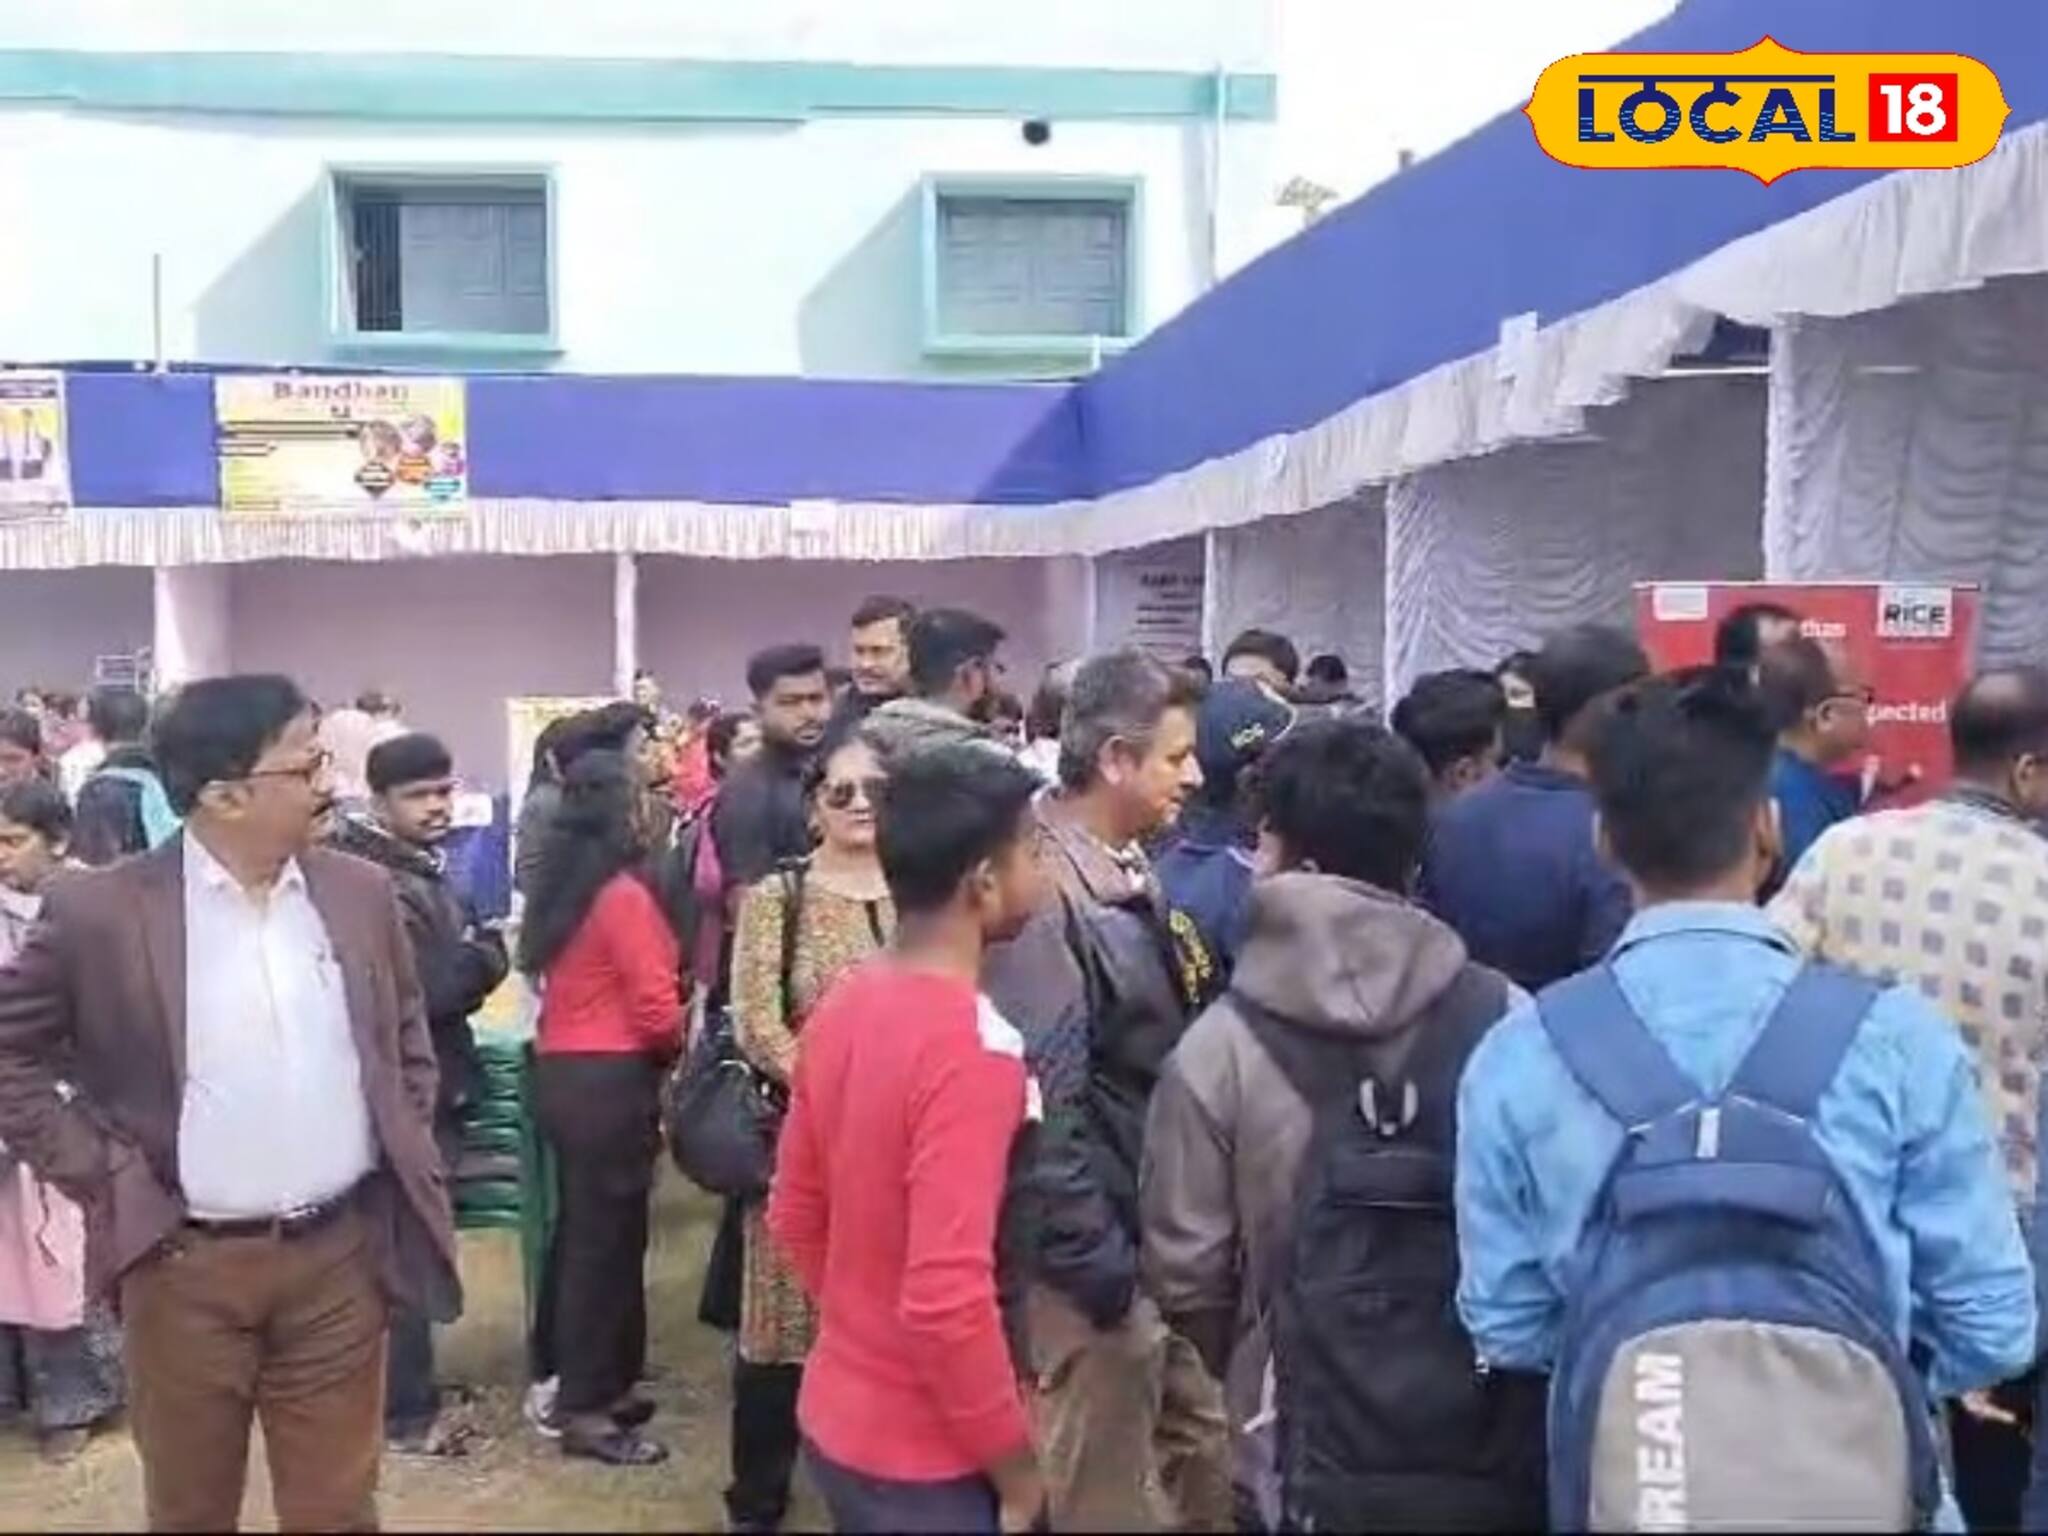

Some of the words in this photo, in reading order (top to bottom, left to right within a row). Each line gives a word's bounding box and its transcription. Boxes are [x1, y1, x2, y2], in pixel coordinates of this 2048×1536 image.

[1884, 604, 1945, 625] RICE
[1866, 700, 1946, 727] pected
[1635, 1354, 1687, 1533] REAM
